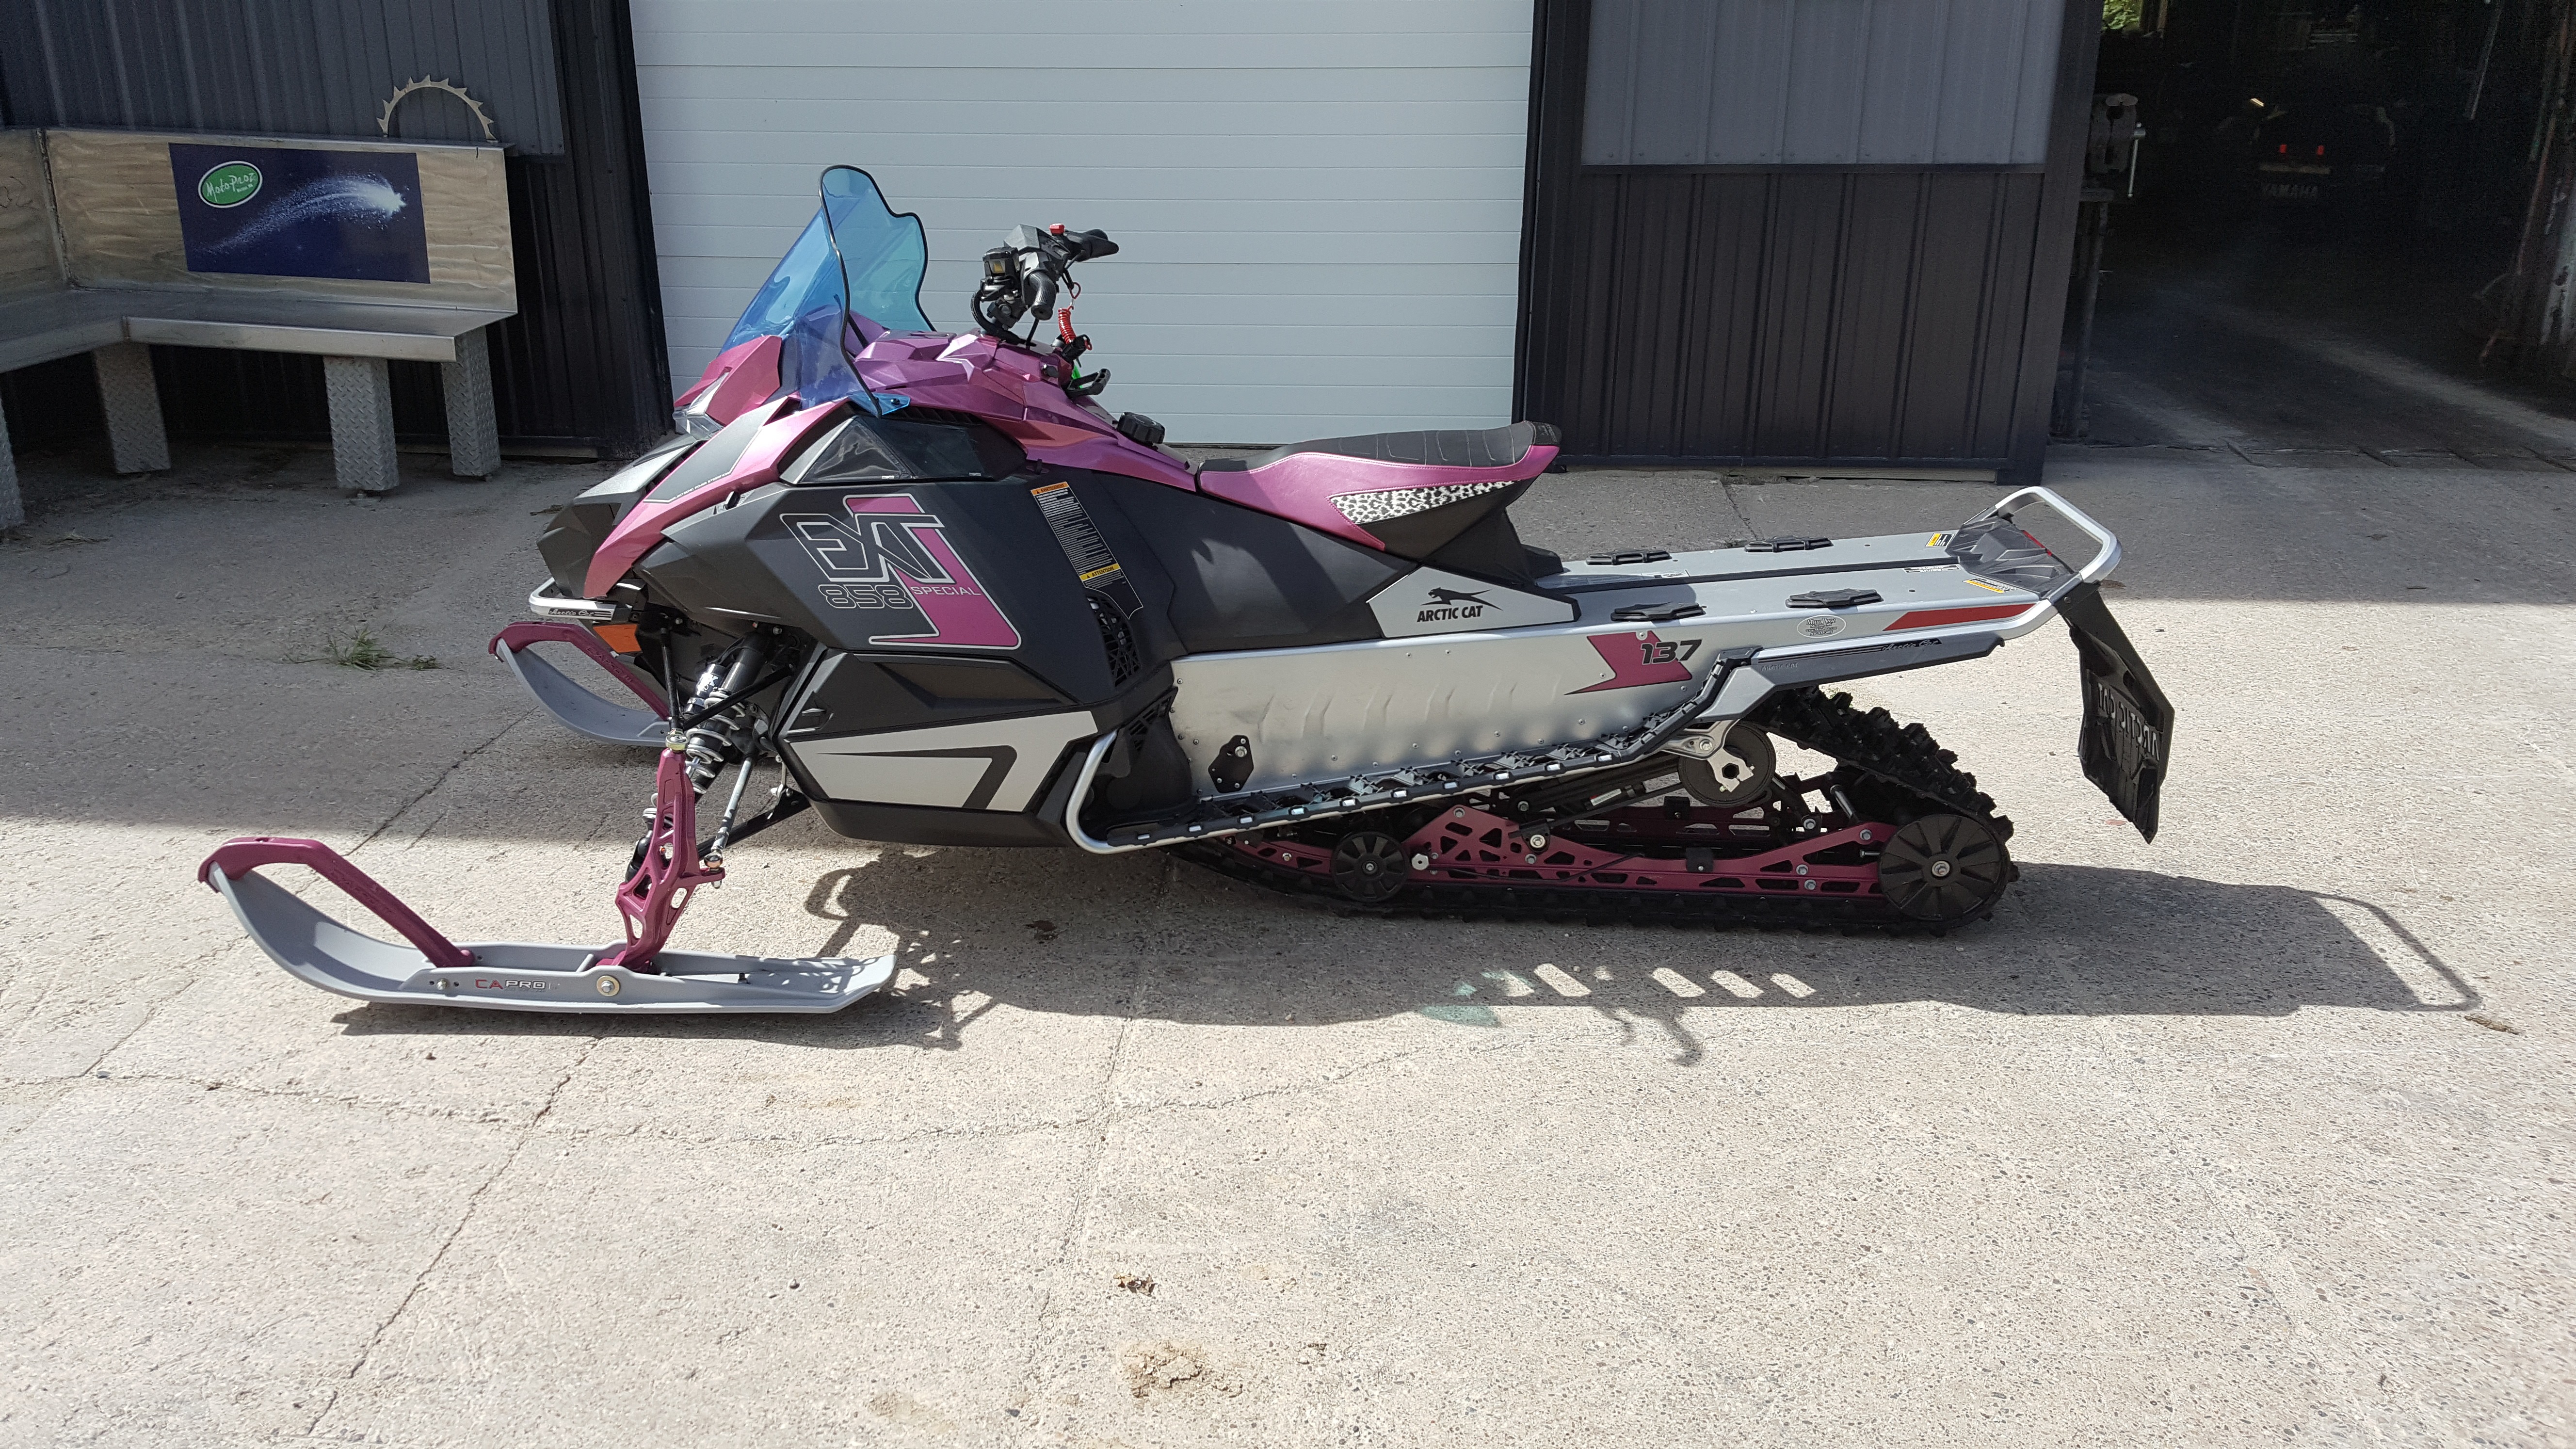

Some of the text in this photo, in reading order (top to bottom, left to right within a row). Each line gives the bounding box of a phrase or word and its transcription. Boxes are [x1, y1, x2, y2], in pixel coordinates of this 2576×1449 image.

[2261, 183, 2318, 199] YAMAHA
[1092, 566, 1114, 577] ATTENTION
[818, 584, 982, 609] 858 SPECIAL
[1417, 605, 1483, 623] ARCTIC CAT
[1641, 639, 1703, 665] 137
[1882, 643, 1916, 651] Arctic
